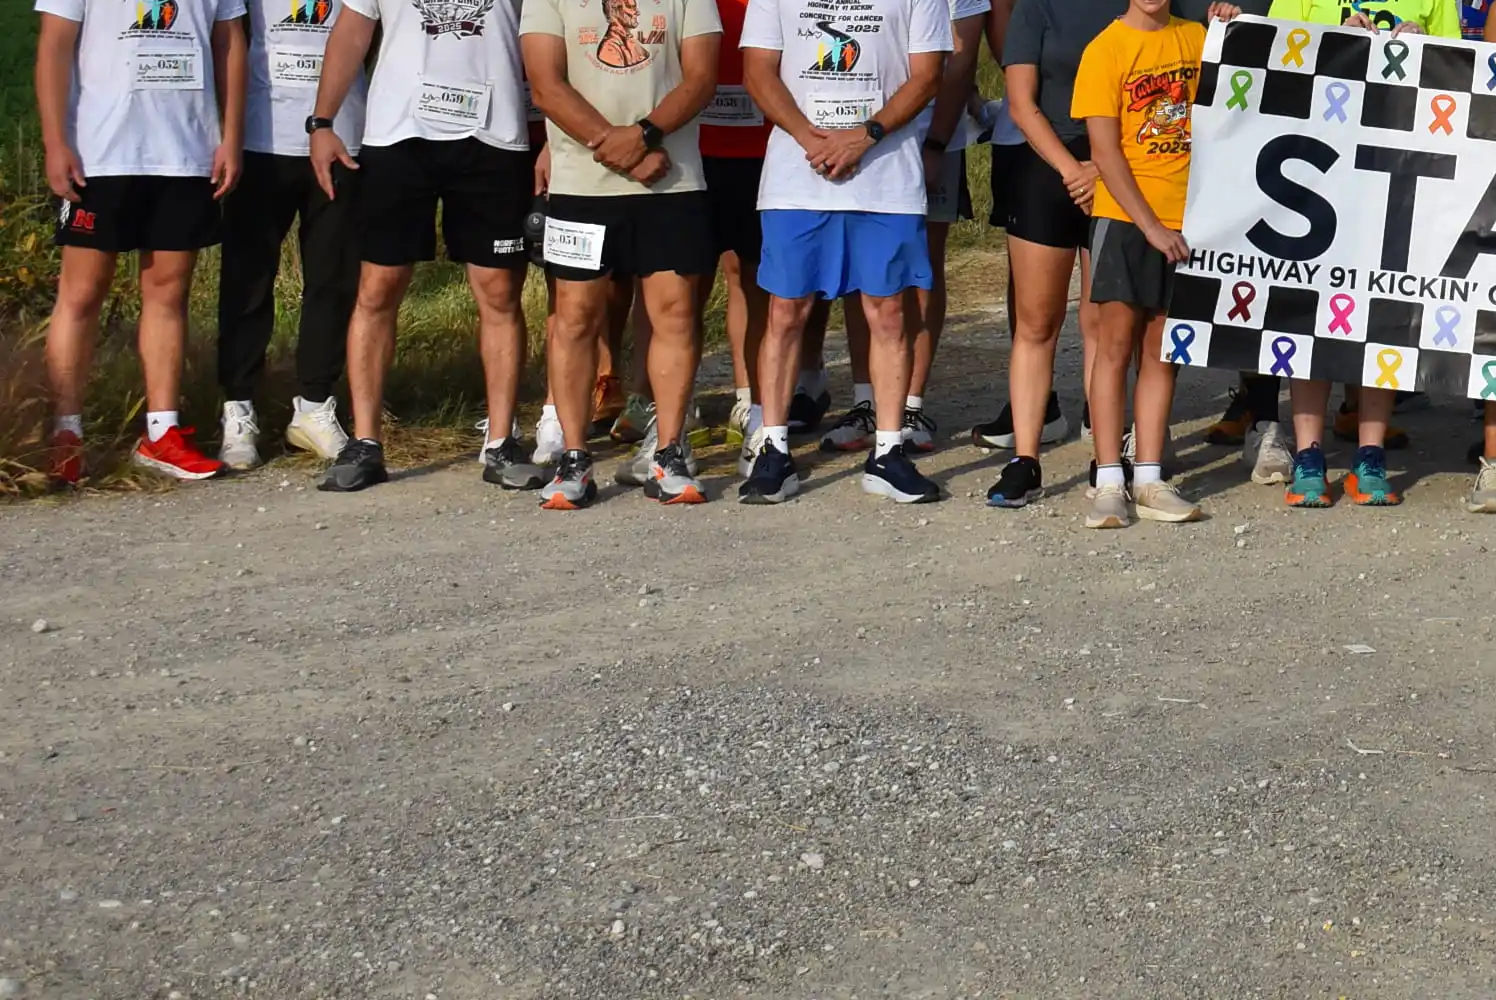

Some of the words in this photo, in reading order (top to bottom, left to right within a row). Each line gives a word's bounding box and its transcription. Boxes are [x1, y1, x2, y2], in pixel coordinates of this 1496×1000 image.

[808, 2, 840, 11] HIGHWAY
[799, 12, 837, 21] CONCRETE
[438, 22, 462, 33] 2025
[845, 24, 881, 33] 2025
[441, 92, 464, 104] 059
[835, 105, 858, 116] 055
[72, 208, 97, 230] N
[1187, 247, 1321, 285] HIGHWAY
[1329, 266, 1358, 290] 91
[1367, 269, 1479, 301] KICKIN'
